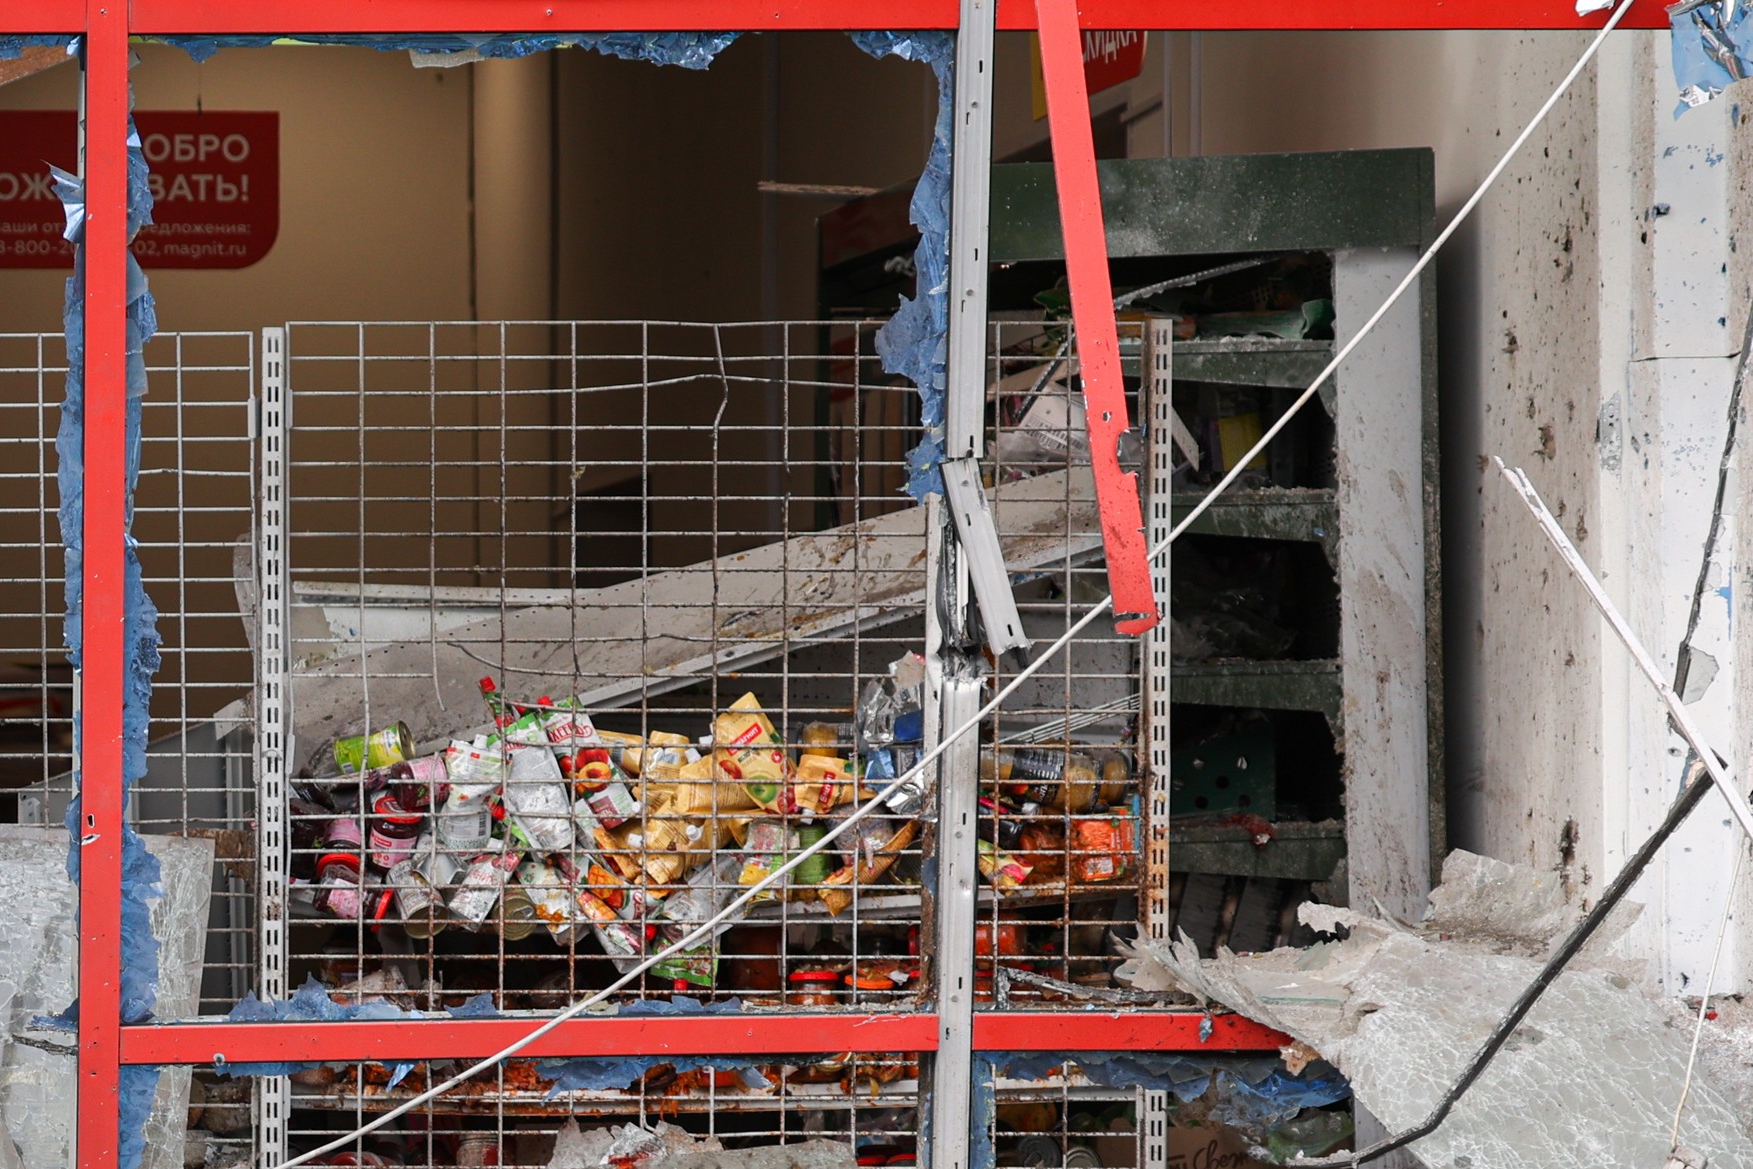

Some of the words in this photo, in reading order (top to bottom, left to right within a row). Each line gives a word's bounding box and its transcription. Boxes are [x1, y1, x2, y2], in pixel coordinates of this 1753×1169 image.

[143, 133, 250, 162] ОБРО
[139, 223, 251, 237] редложения:
[164, 240, 247, 259] magnit.ru
